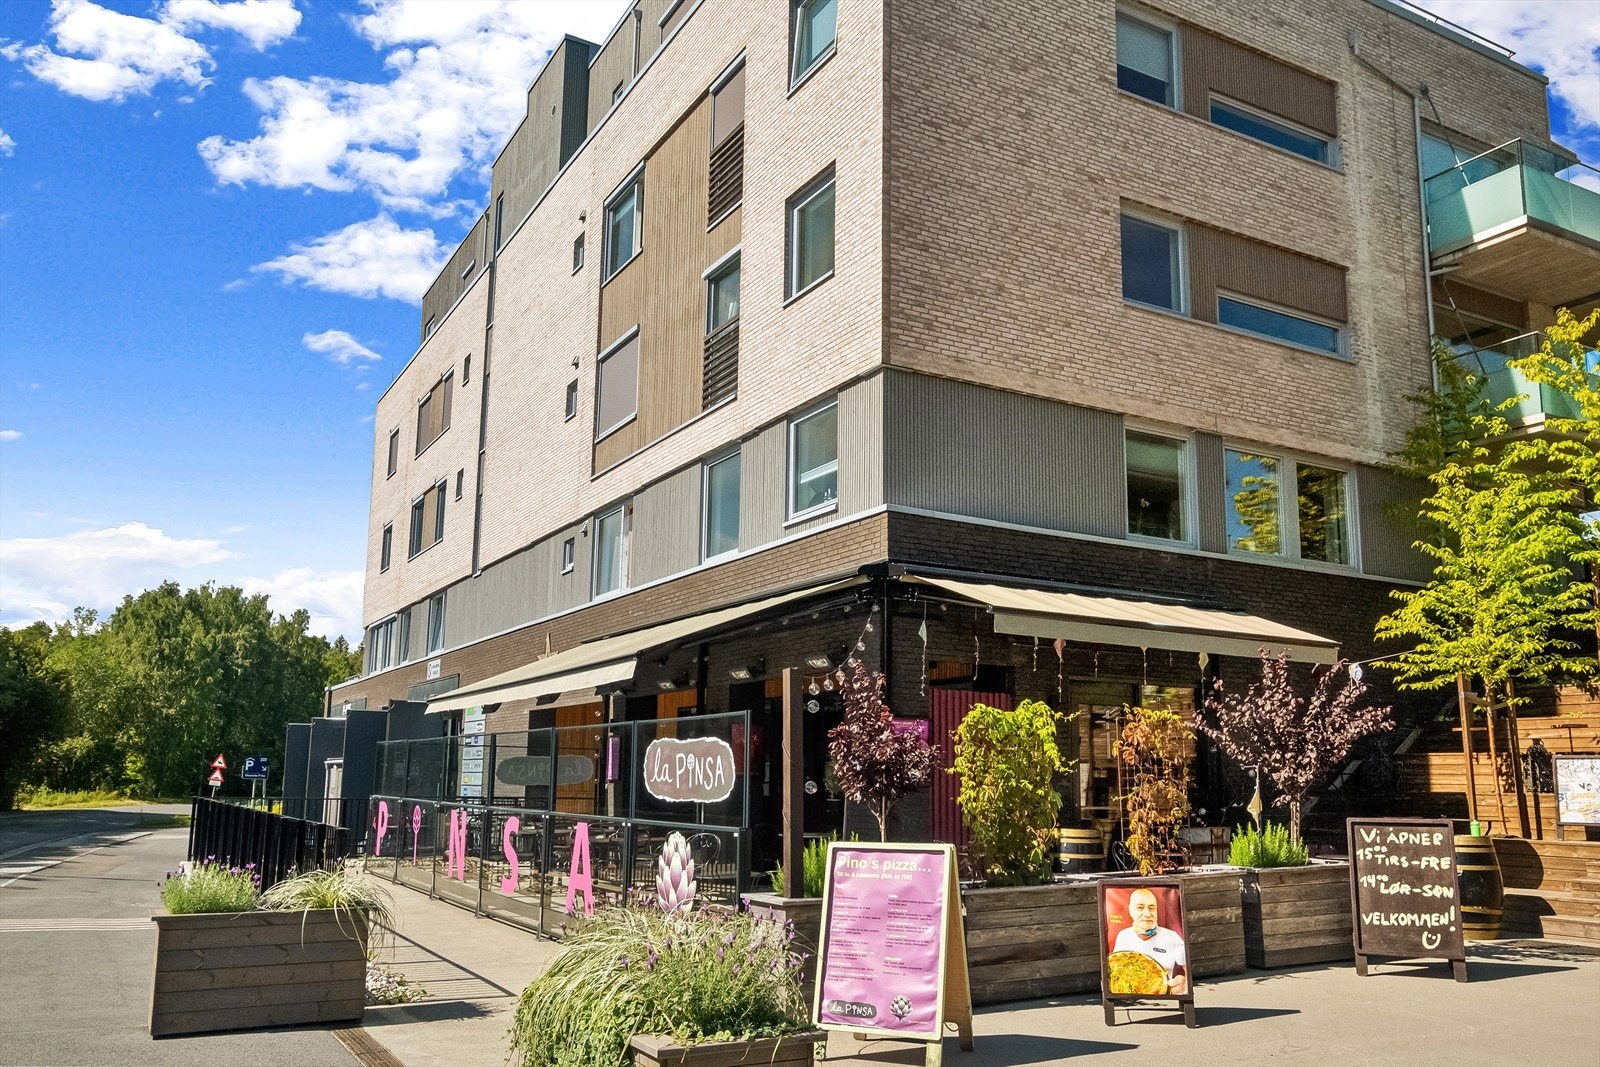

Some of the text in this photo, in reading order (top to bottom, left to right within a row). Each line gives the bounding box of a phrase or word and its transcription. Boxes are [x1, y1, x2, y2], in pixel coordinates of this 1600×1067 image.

[245, 760, 254, 771] P
[650, 747, 673, 782] la
[676, 753, 725, 790] PINSA
[1387, 827, 1443, 846] ÅPNER
[830, 1001, 873, 1017] la PINSA
